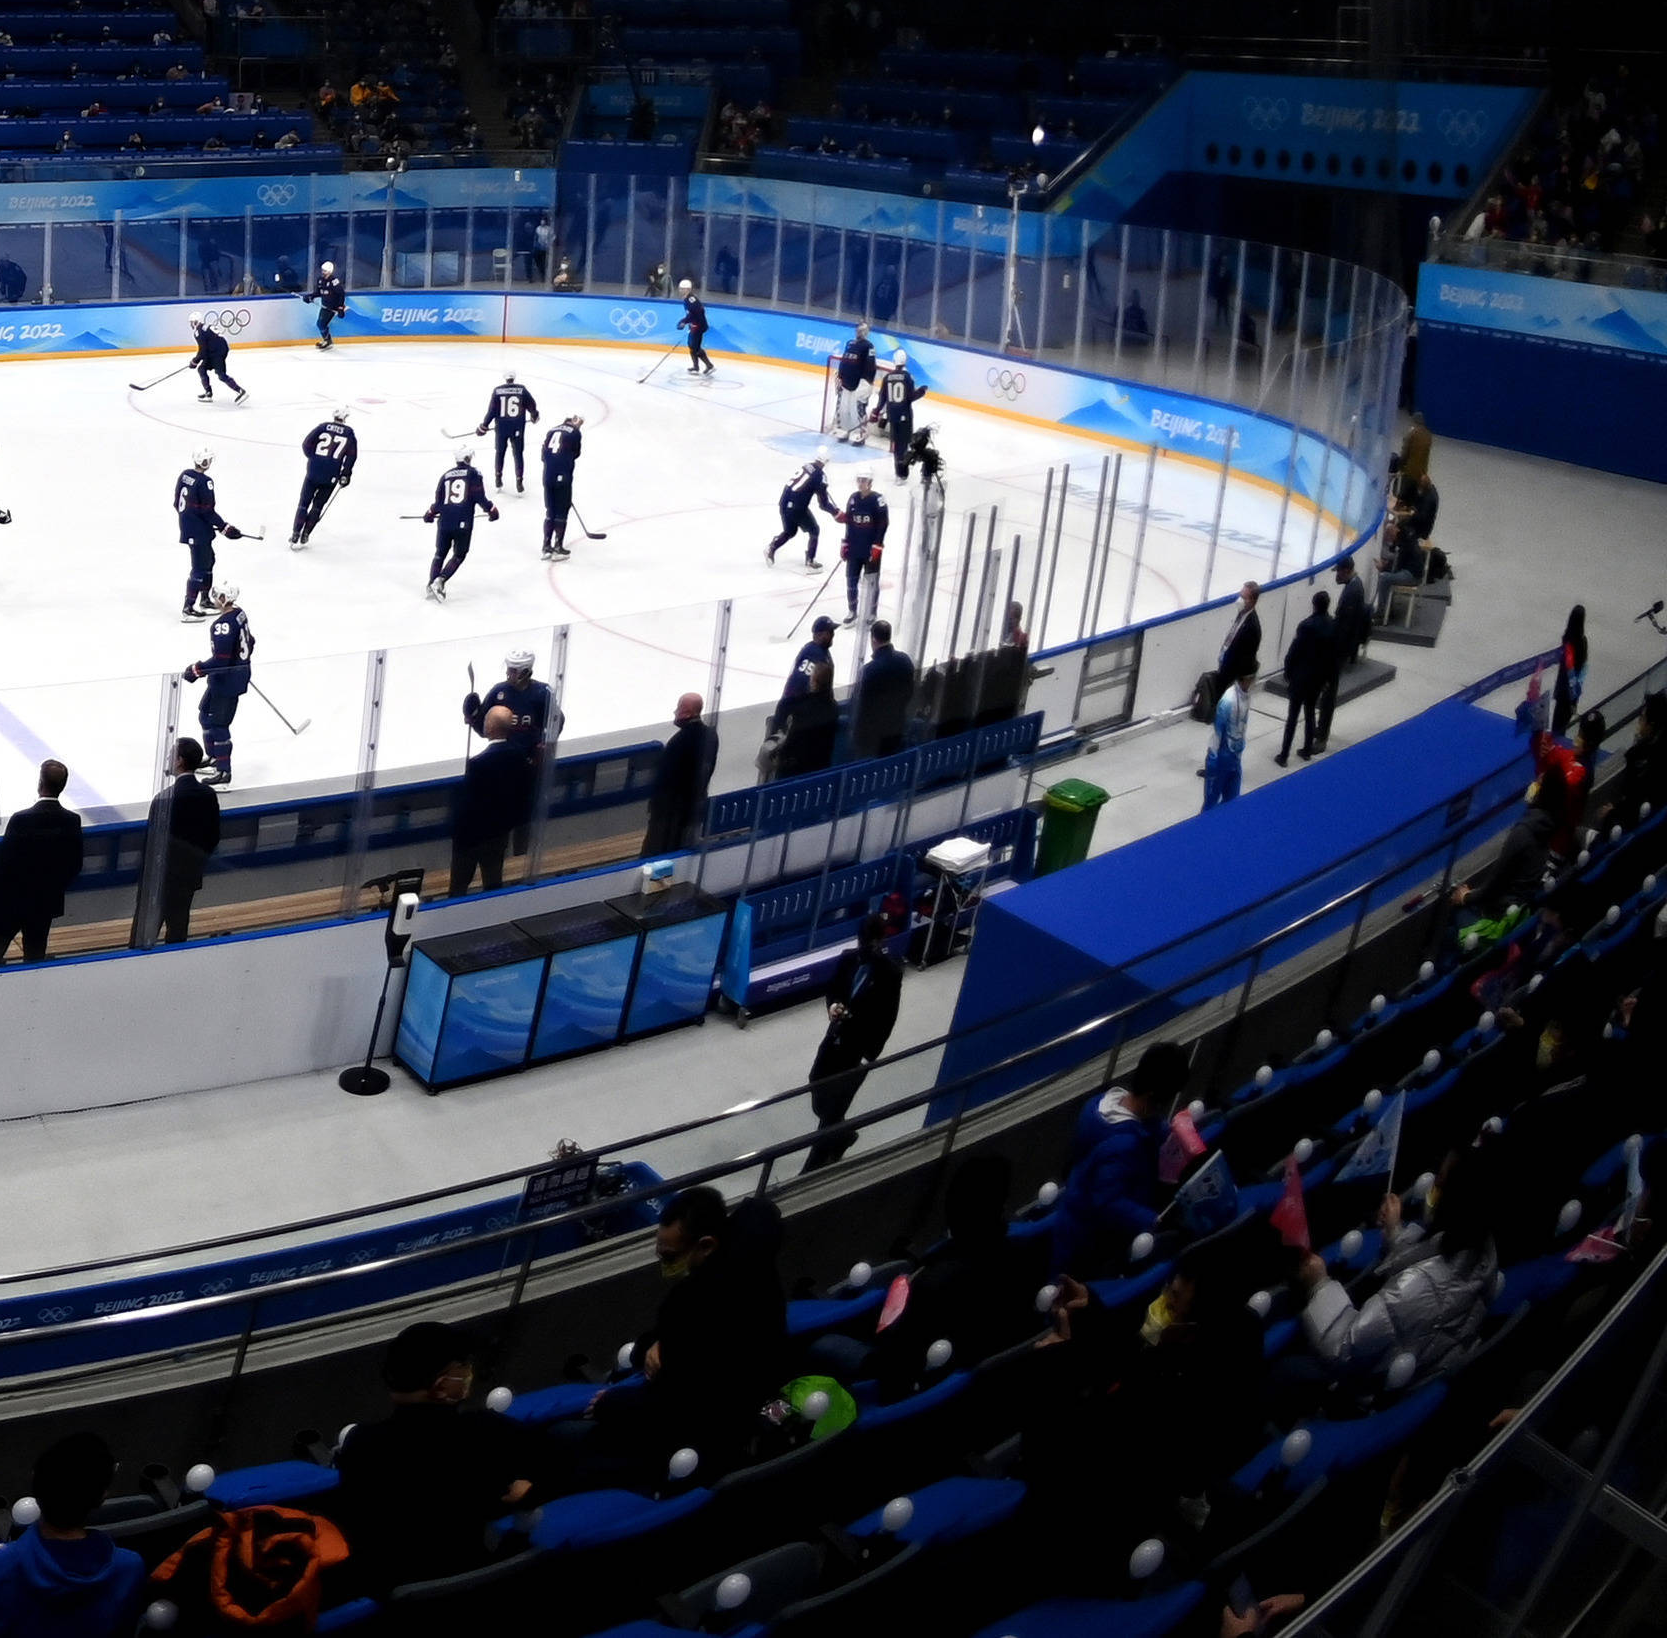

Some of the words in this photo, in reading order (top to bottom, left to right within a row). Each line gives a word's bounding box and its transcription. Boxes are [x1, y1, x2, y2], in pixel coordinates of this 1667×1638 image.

[8, 196, 58, 210] BEIJING
[60, 195, 95, 207] 2022
[380, 306, 439, 326] BEIJING
[442, 308, 484, 323] 2022
[18, 323, 66, 339] 2022
[886, 381, 905, 404] 10
[499, 395, 520, 418] 16
[1150, 408, 1204, 440] BEIJING
[314, 431, 348, 460] 27
[547, 430, 563, 454] 4
[178, 486, 188, 513] 6
[443, 478, 466, 505] 19
[213, 621, 230, 636] 39
[511, 714, 532, 726] SA
[395, 1233, 440, 1253] BEIJING
[441, 1226, 473, 1241] 2022
[249, 1266, 297, 1284] BEIJING
[299, 1258, 332, 1276] 2022
[93, 1298, 145, 1315] BEIJING
[148, 1290, 186, 1307] 2022
